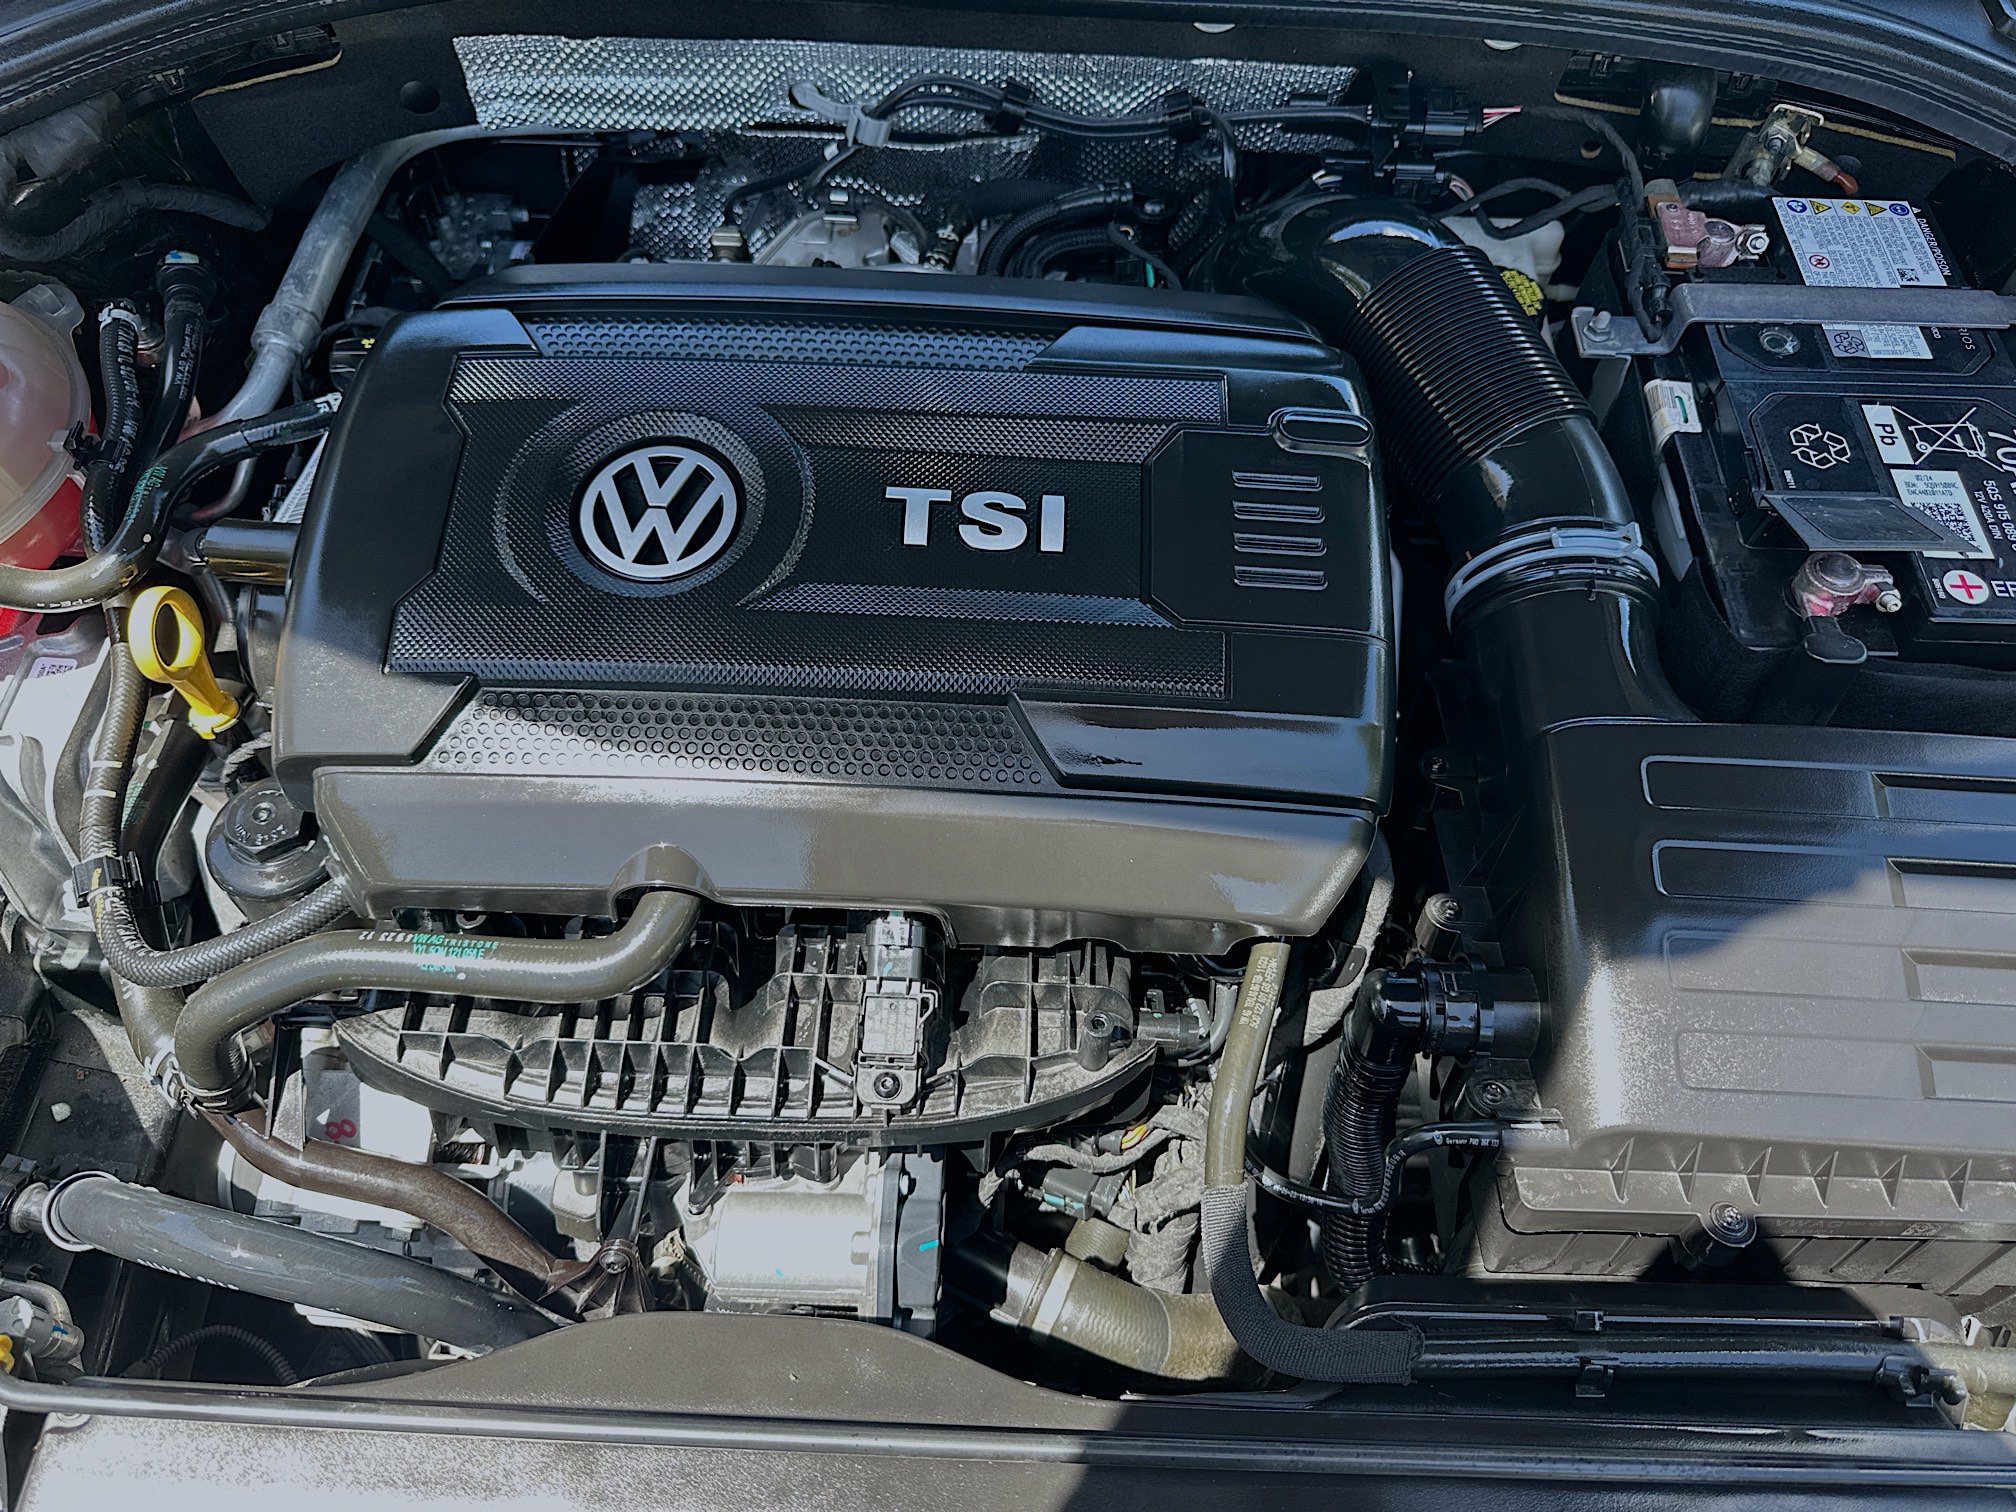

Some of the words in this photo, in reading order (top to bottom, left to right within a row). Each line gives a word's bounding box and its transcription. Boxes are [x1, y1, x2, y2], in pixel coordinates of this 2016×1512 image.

[1915, 217, 1952, 275] DANGER/POISON
[1874, 423, 1896, 446] Pb
[1974, 491, 1987, 506] 12V
[1983, 479, 2003, 501] 5QS
[885, 485, 1066, 554] TSI
[1980, 505, 1997, 524] 420A
[1993, 502, 2012, 521] 915
[1989, 524, 2003, 540] DIN
[2002, 521, 2016, 546] 089
[1990, 580, 2016, 597] EF
[444, 938, 500, 949] TRISTONE
